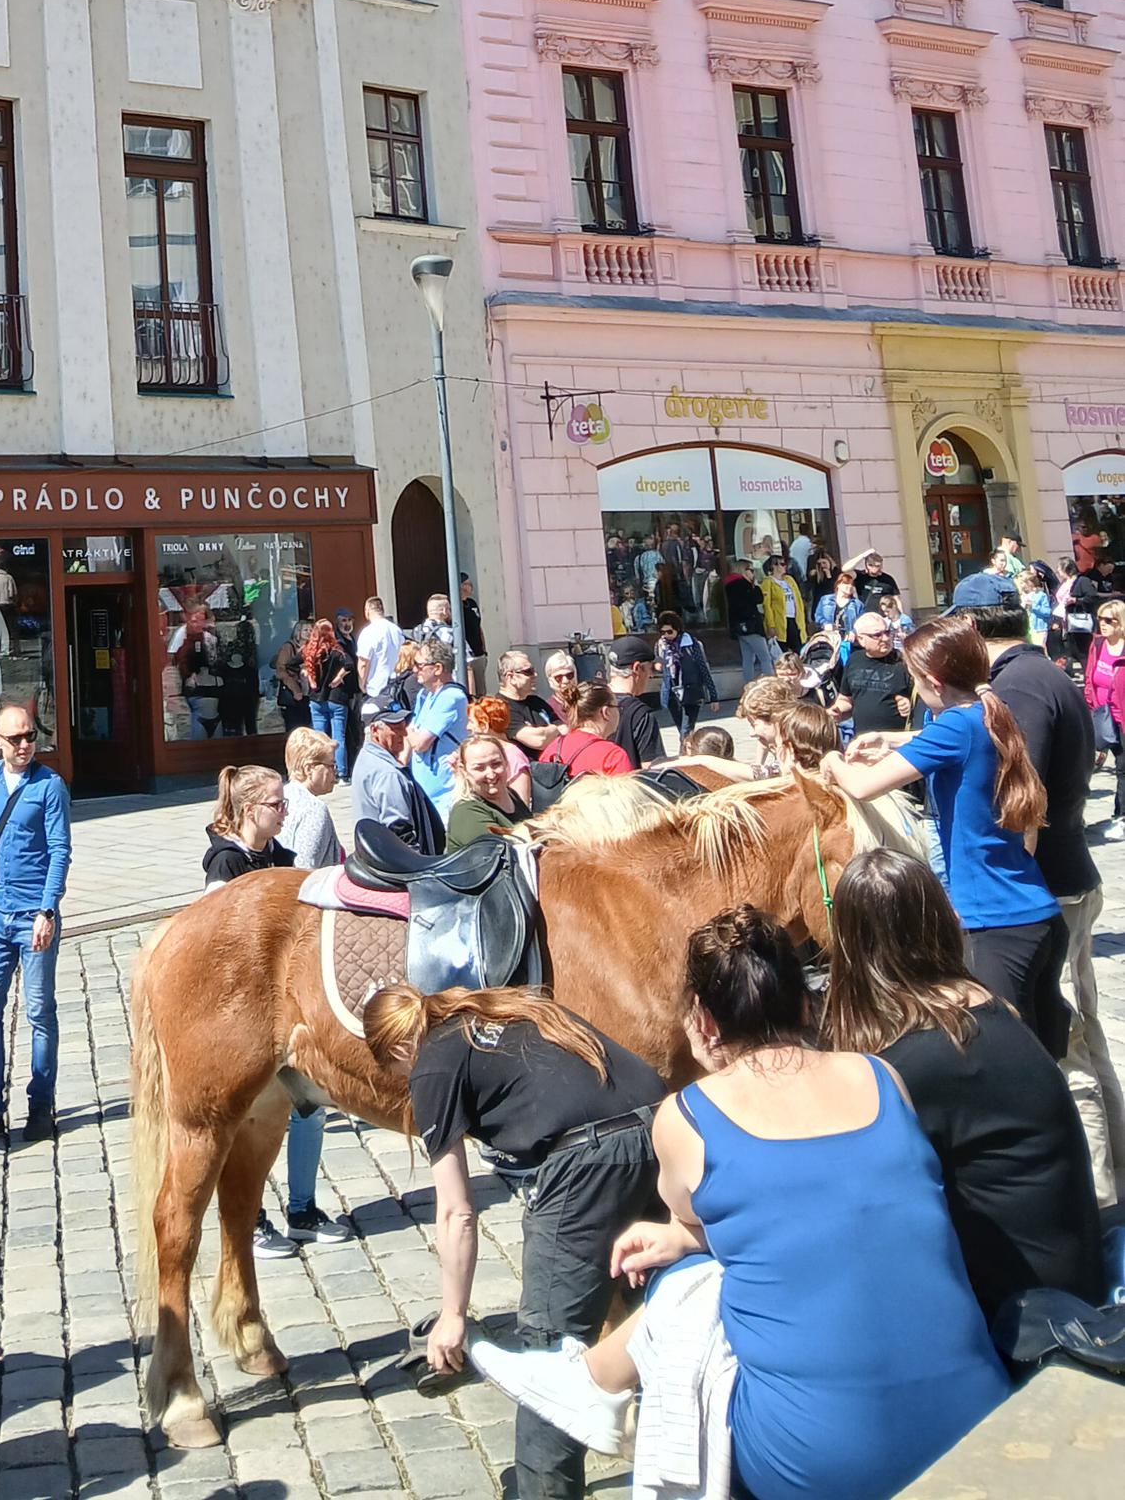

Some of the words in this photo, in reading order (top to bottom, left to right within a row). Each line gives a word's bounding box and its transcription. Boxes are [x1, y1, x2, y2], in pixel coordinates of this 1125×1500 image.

[664, 385, 769, 427] drogerie
[571, 418, 604, 435] teta
[930, 452, 955, 467] teta
[635, 476, 690, 496] drogerie
[739, 476, 803, 492] kosmetika
[144, 487, 162, 511] &
[180, 482, 350, 509] PUNČOCHY
[162, 543, 189, 552] TRIOLA
[198, 543, 224, 551] DKNY
